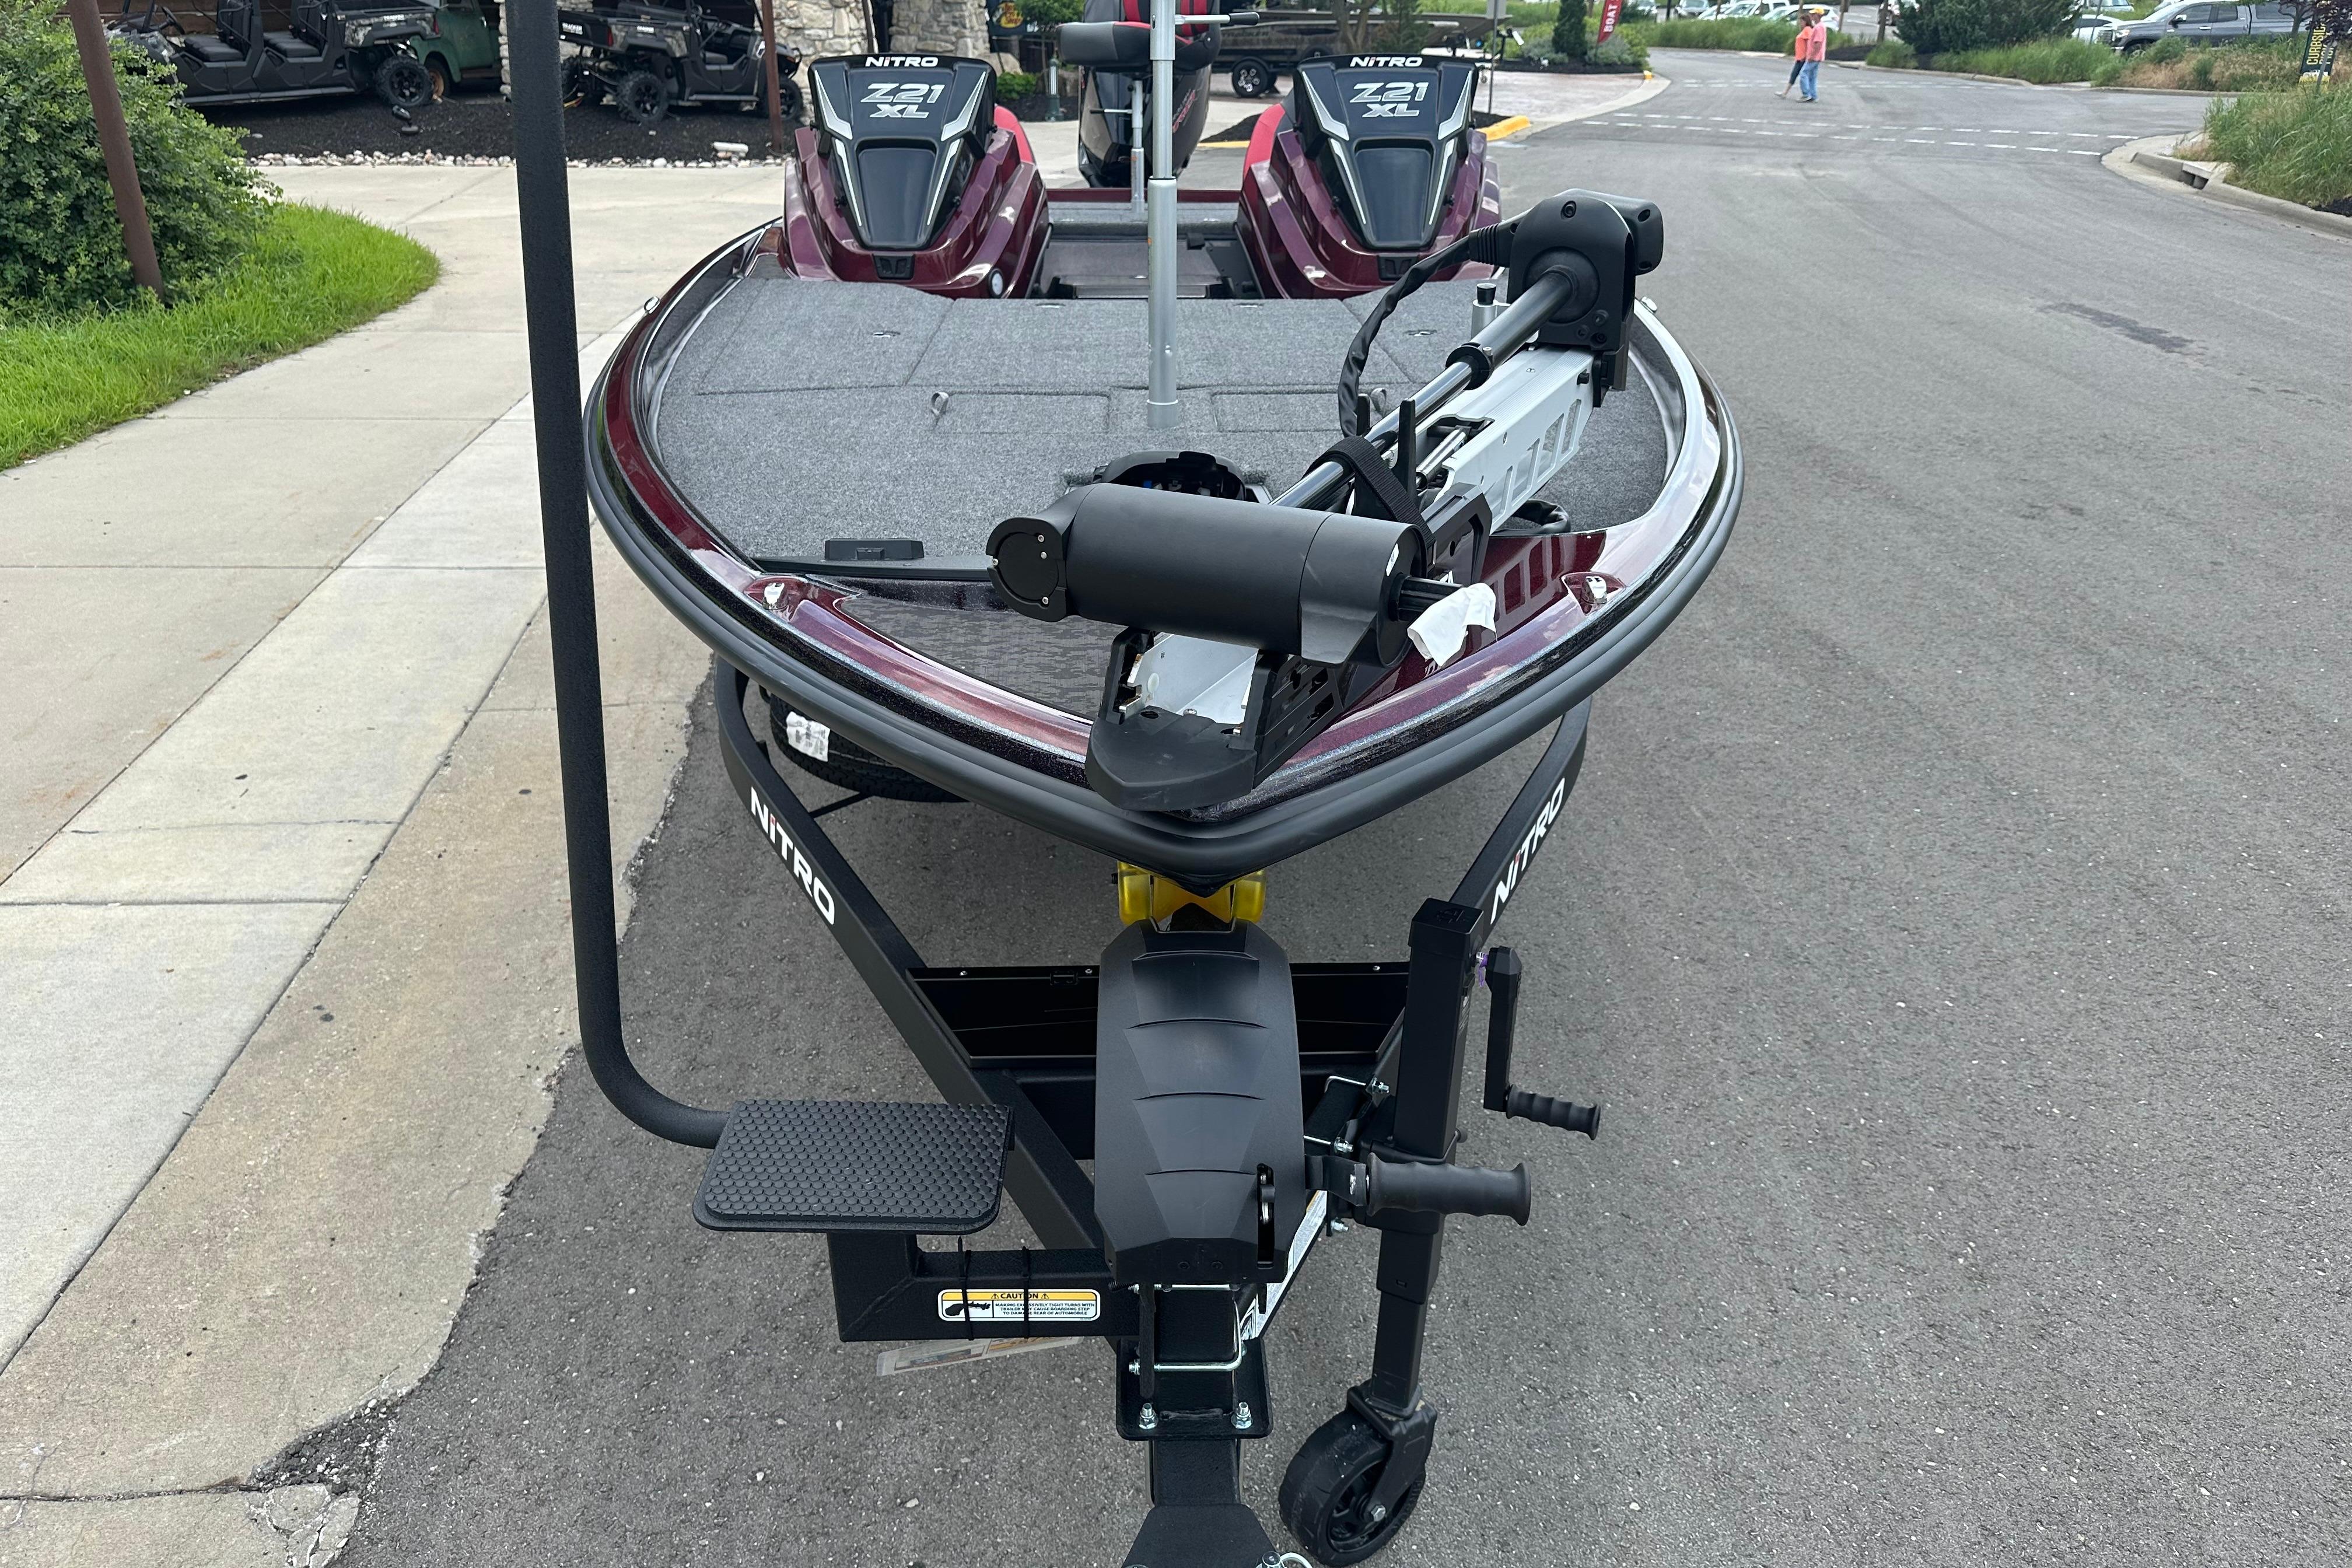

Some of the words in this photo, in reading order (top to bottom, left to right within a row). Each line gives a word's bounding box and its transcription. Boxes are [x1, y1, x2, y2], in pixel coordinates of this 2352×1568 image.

[1603, 4, 1618, 33] BOAT
[2306, 22, 2326, 65] CURBSID
[860, 83, 946, 103] Z21
[1349, 82, 1429, 103] Z21
[869, 104, 929, 118] XL
[1362, 103, 1420, 117] XL
